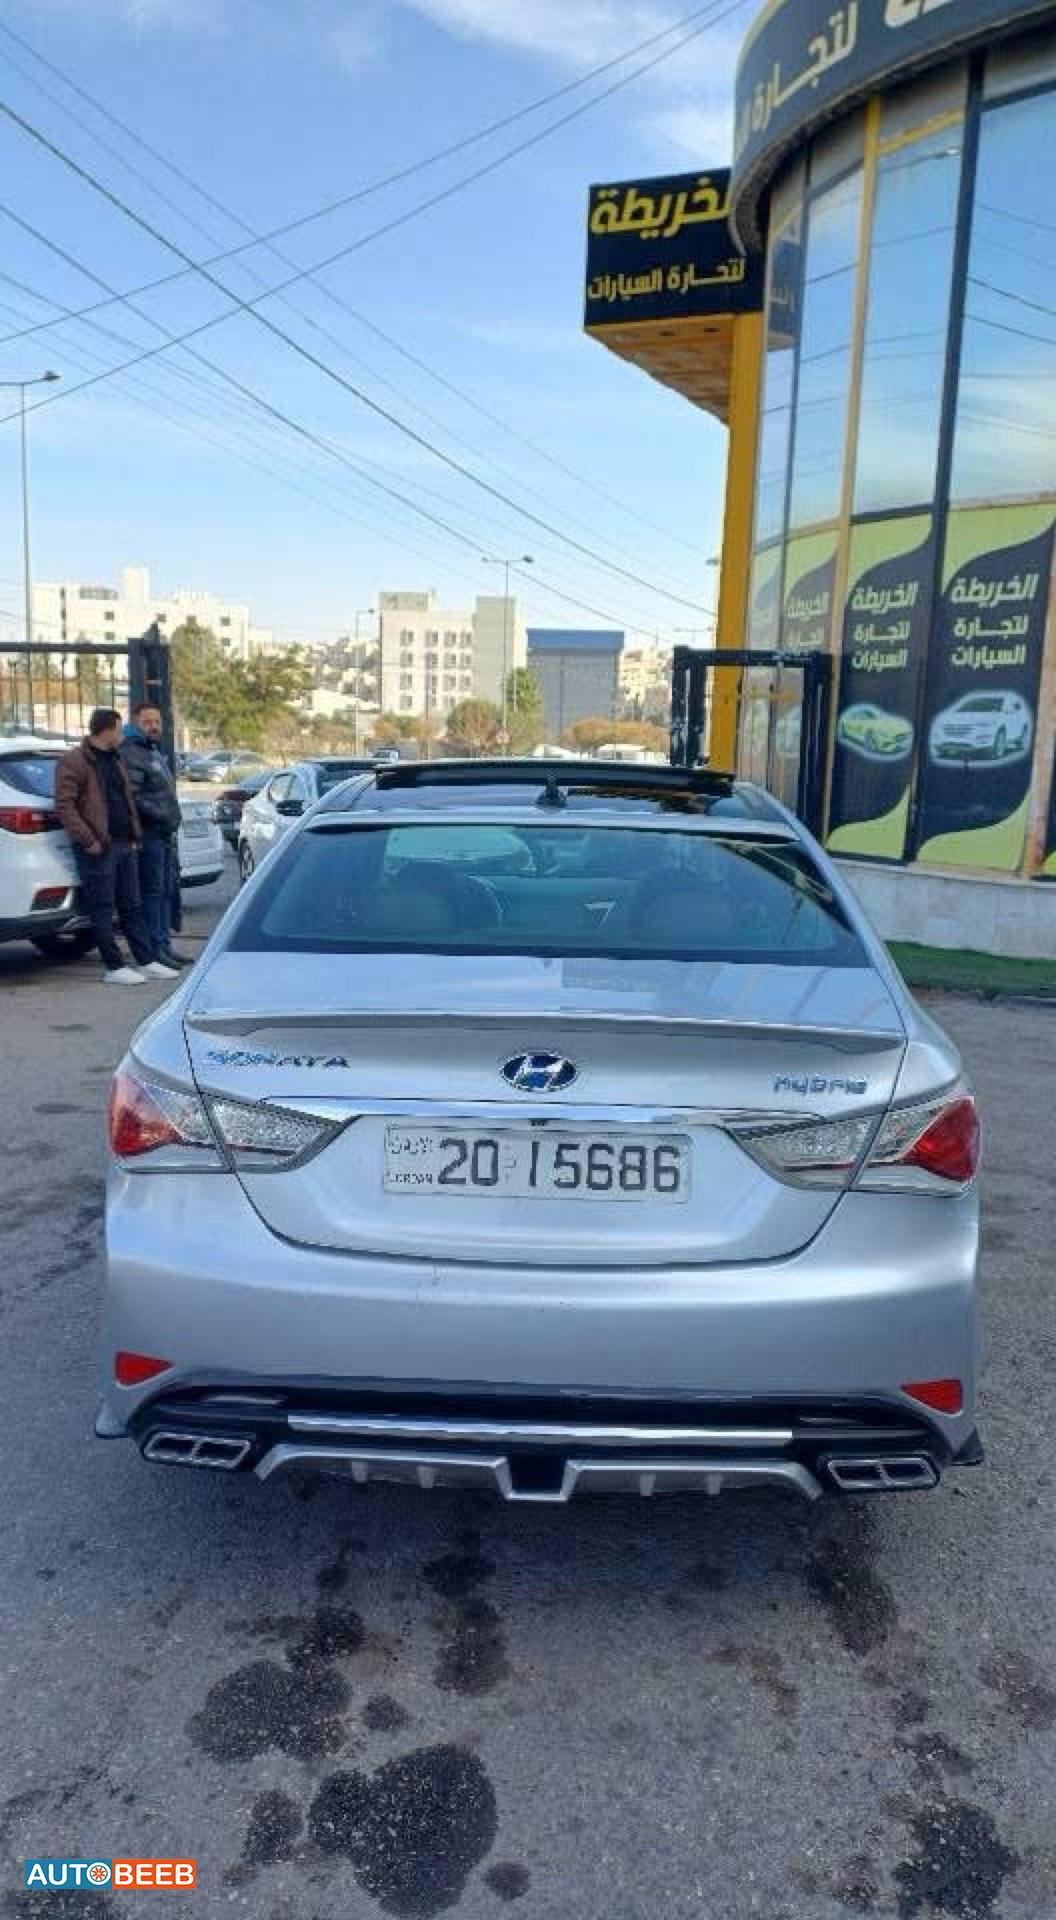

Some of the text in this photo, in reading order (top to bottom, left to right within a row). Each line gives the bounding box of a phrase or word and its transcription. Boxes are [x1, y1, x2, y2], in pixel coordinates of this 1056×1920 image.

[852, 581, 919, 615] الخريطة
[951, 573, 1039, 608] الخريطة
[953, 615, 1029, 640] لتجارة
[951, 644, 1026, 670] السيارات
[207, 1050, 351, 1069] SONATA
[438, 1138, 499, 1186] 20
